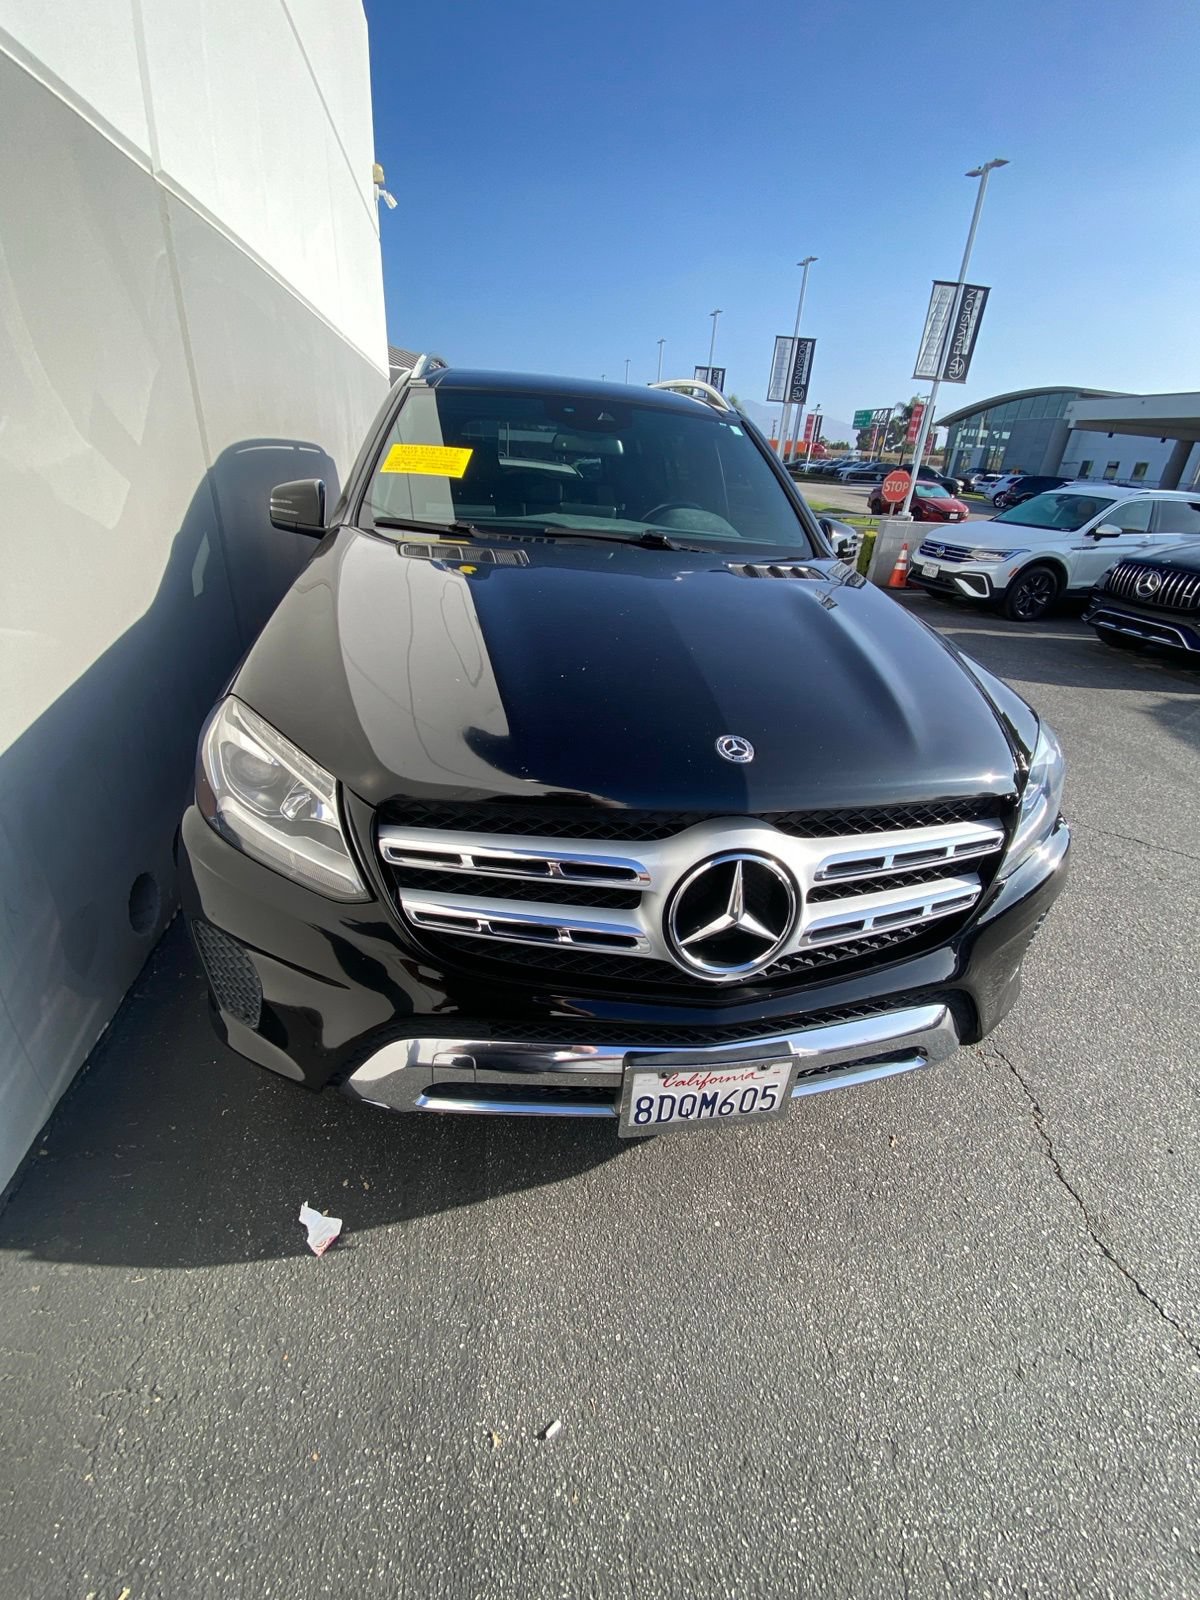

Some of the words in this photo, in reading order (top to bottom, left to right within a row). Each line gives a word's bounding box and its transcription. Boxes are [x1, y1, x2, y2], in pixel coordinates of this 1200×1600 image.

[953, 288, 978, 354] ENVISION
[794, 340, 808, 385] ENVISION
[883, 480, 909, 493] STOP
[663, 1071, 765, 1090] California
[634, 1084, 778, 1125] 8DQM605
